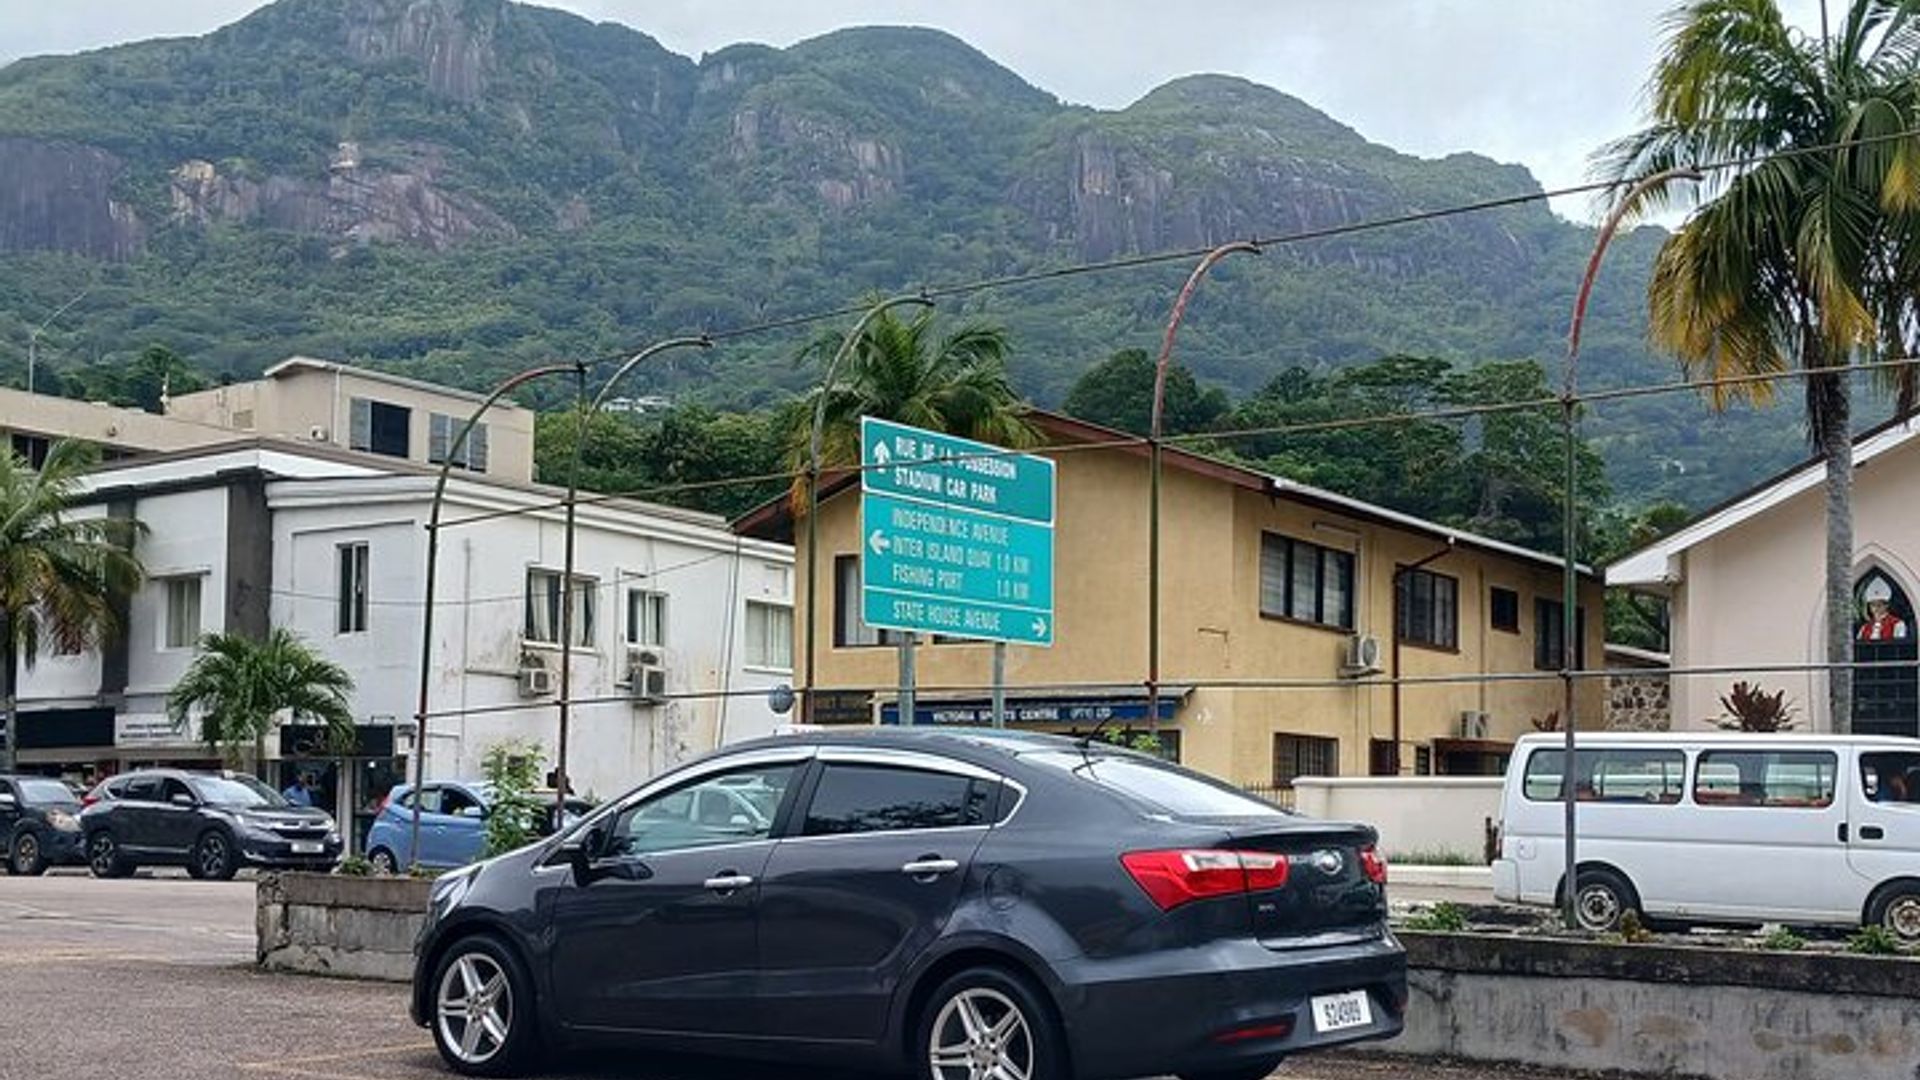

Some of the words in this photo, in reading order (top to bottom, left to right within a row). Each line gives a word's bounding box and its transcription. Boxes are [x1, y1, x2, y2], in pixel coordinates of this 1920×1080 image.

[896, 436, 916, 458] RUE
[923, 442, 935, 461] DE
[958, 451, 1017, 480] POSSESSION
[895, 465, 942, 493] STADIUM
[947, 478, 967, 499] CAR
[971, 482, 997, 504] PARK
[893, 508, 968, 539] INDEPENDENCE
[972, 523, 1008, 546] AVENUE
[893, 535, 924, 559] INTER
[926, 541, 963, 566] ISLAND
[966, 548, 992, 569] QUAY
[893, 563, 934, 587] FISHING
[937, 569, 963, 592] PORT
[893, 600, 924, 622] STATE
[928, 604, 961, 627] HOUSE
[963, 609, 1001, 632] AVENUE
